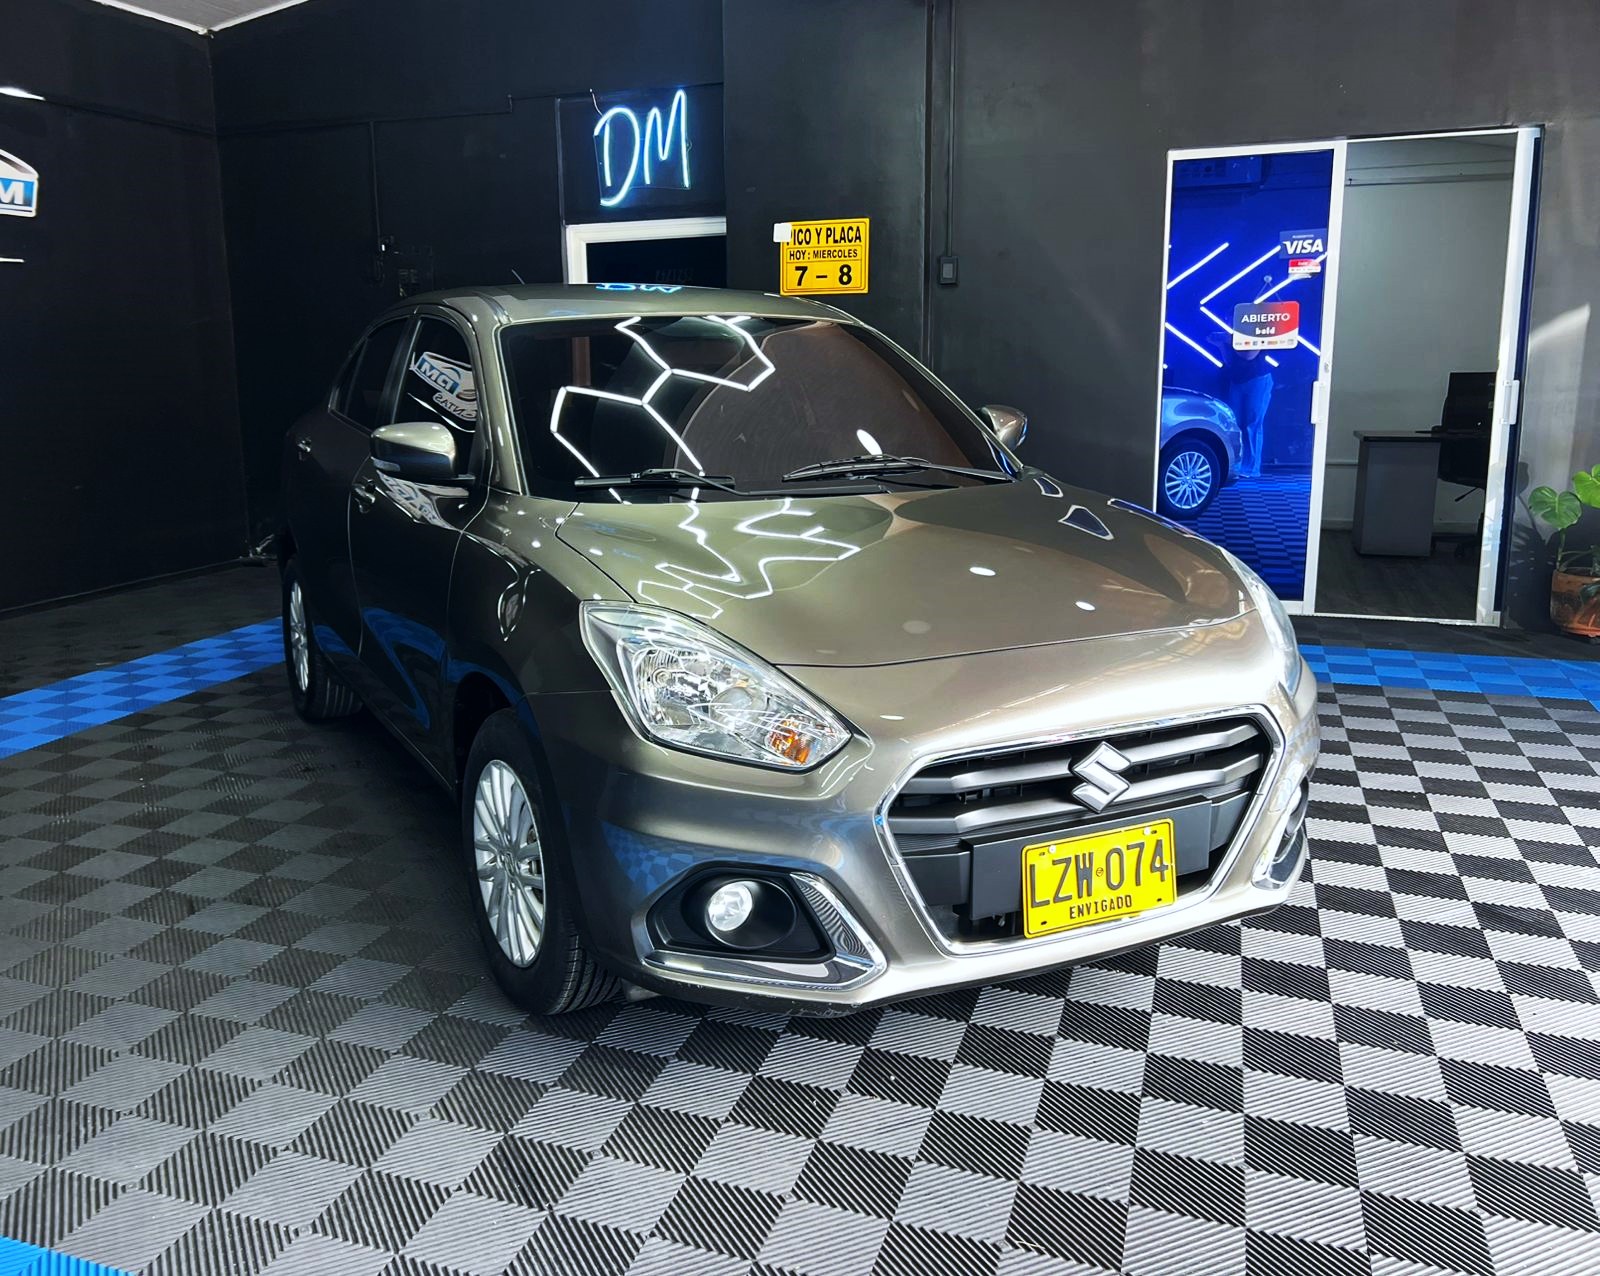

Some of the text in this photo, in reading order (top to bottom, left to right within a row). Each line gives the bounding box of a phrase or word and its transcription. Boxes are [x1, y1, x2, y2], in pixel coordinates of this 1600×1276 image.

[594, 89, 689, 206] DM
[786, 226, 862, 246] ICO Y PLACA
[1282, 239, 1323, 254] VISA
[813, 249, 858, 259] MIERCOLES
[795, 265, 808, 287] 7
[838, 264, 852, 286] 8
[1241, 313, 1290, 323] ABIERTO
[1029, 839, 1169, 909] LZW 074
[1069, 894, 1132, 919] ENVIGADO
